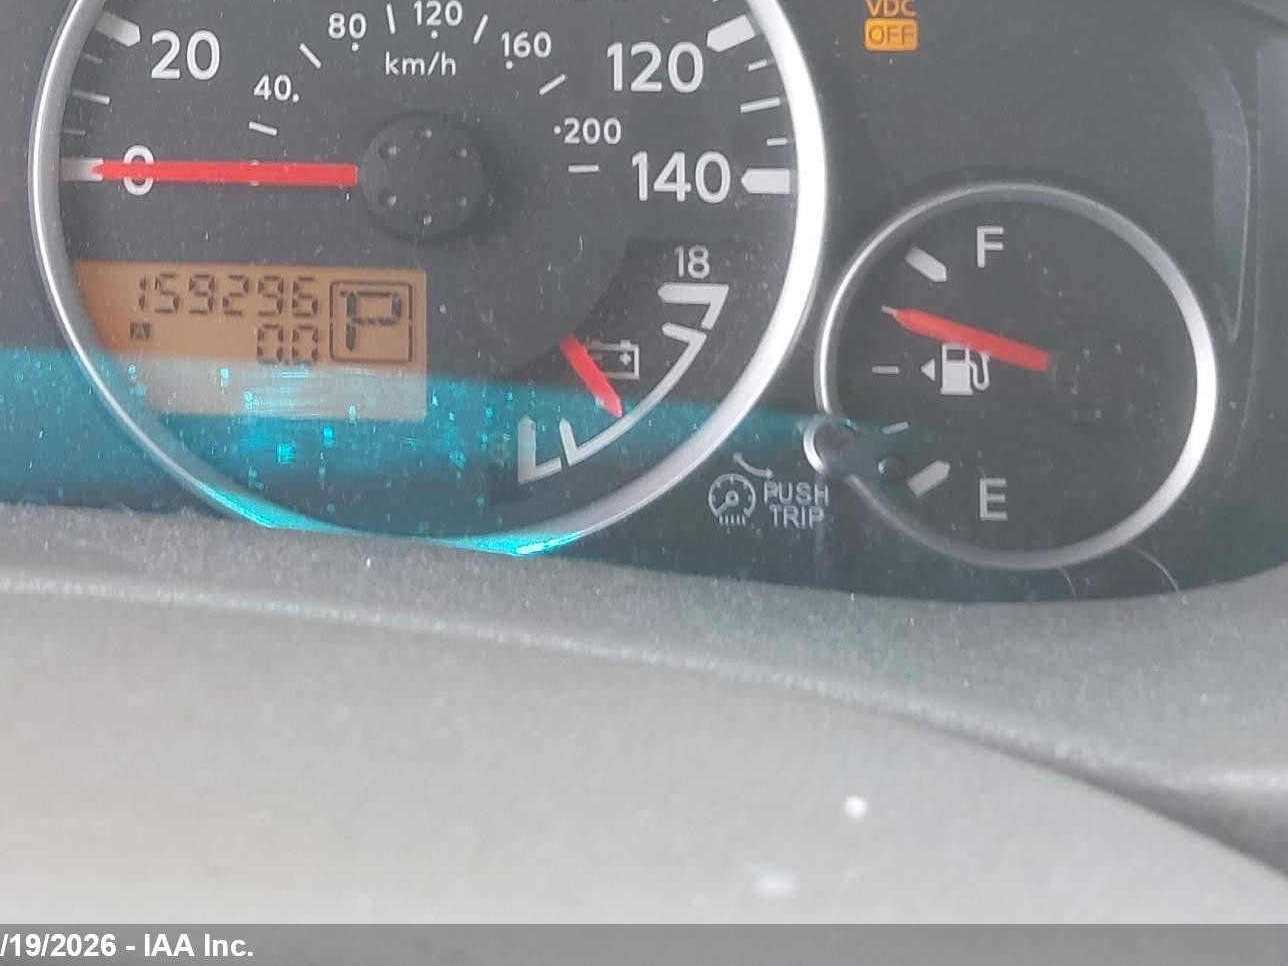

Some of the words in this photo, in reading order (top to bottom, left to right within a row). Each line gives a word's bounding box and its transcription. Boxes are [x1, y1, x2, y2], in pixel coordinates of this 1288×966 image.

[328, 13, 367, 40] 80
[413, 0, 463, 27] 120
[501, 31, 552, 59] 160
[869, 24, 915, 45] OFF
[150, 31, 221, 81] 20
[385, 51, 457, 78] km/h
[607, 42, 704, 94] 120
[563, 117, 623, 145] 200
[631, 151, 732, 204] 140
[976, 225, 1005, 269] F
[675, 246, 710, 278] 18
[139, 273, 319, 318] 159296
[339, 290, 403, 352] P
[764, 481, 830, 506] PUSH
[979, 477, 1008, 521] E
[769, 505, 825, 529] TRIP
